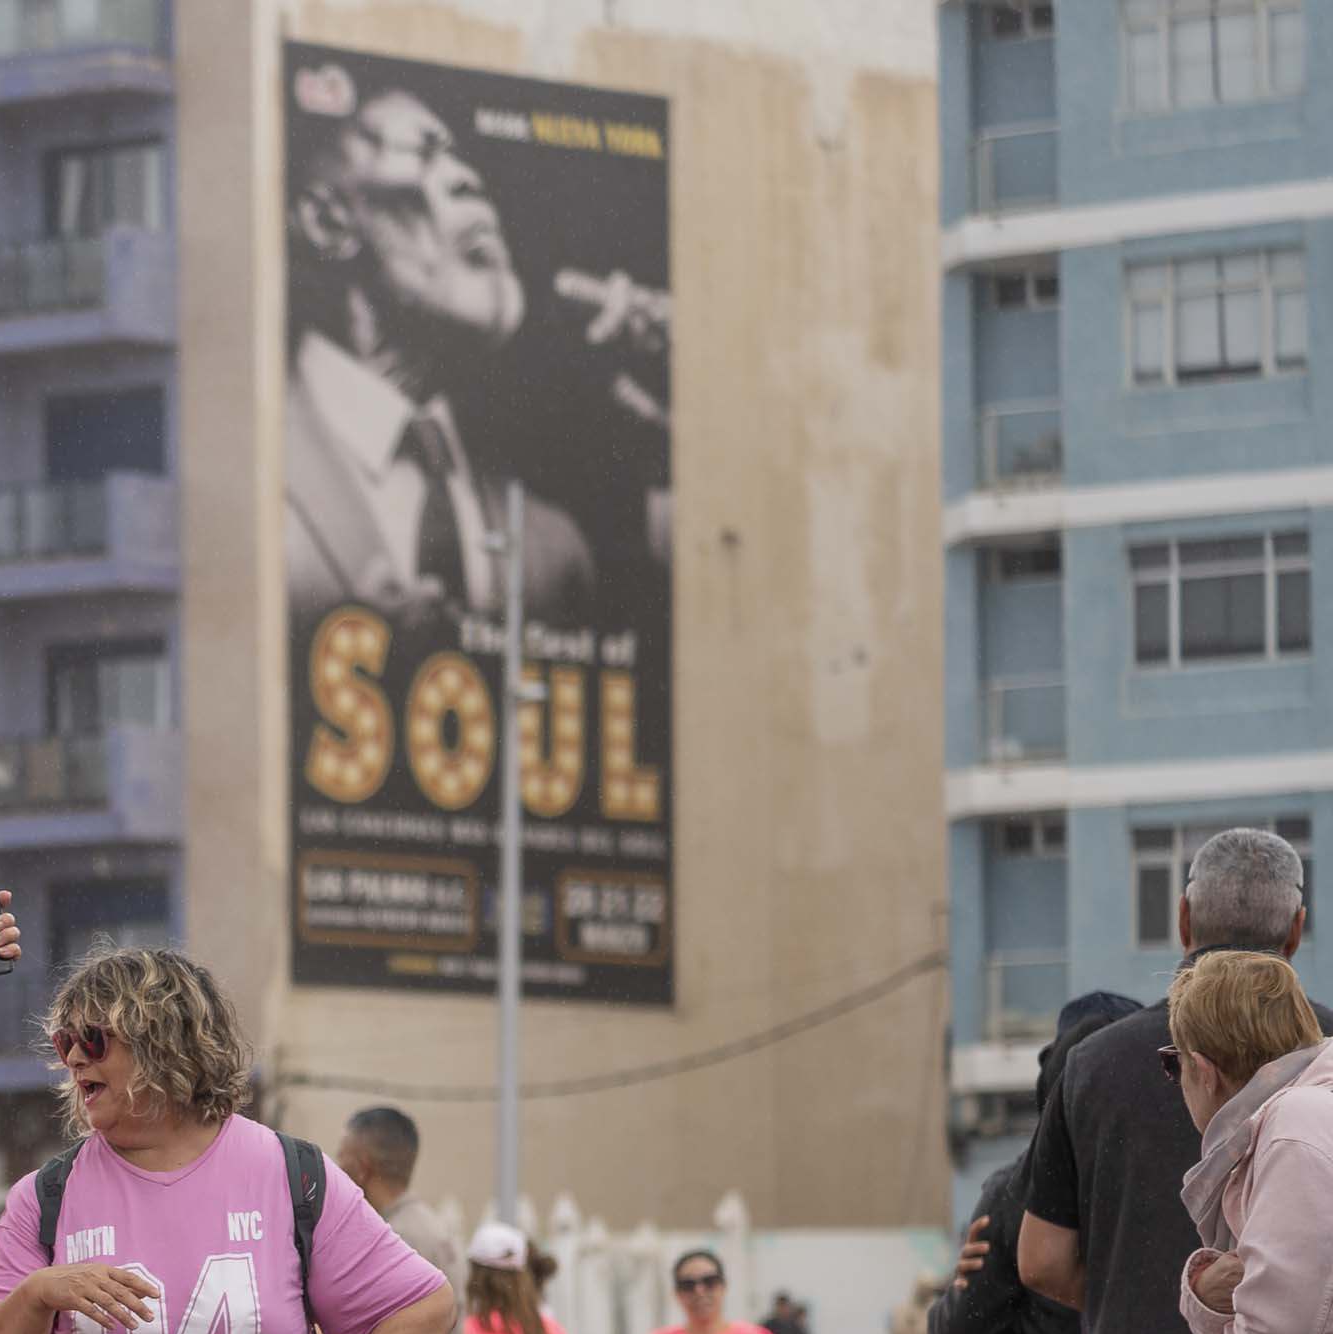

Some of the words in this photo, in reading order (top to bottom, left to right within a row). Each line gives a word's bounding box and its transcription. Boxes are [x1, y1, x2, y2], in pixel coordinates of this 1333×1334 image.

[304, 604, 662, 823] SOUL
[66, 1225, 116, 1265] MHTN
[227, 1210, 263, 1241] NYC
